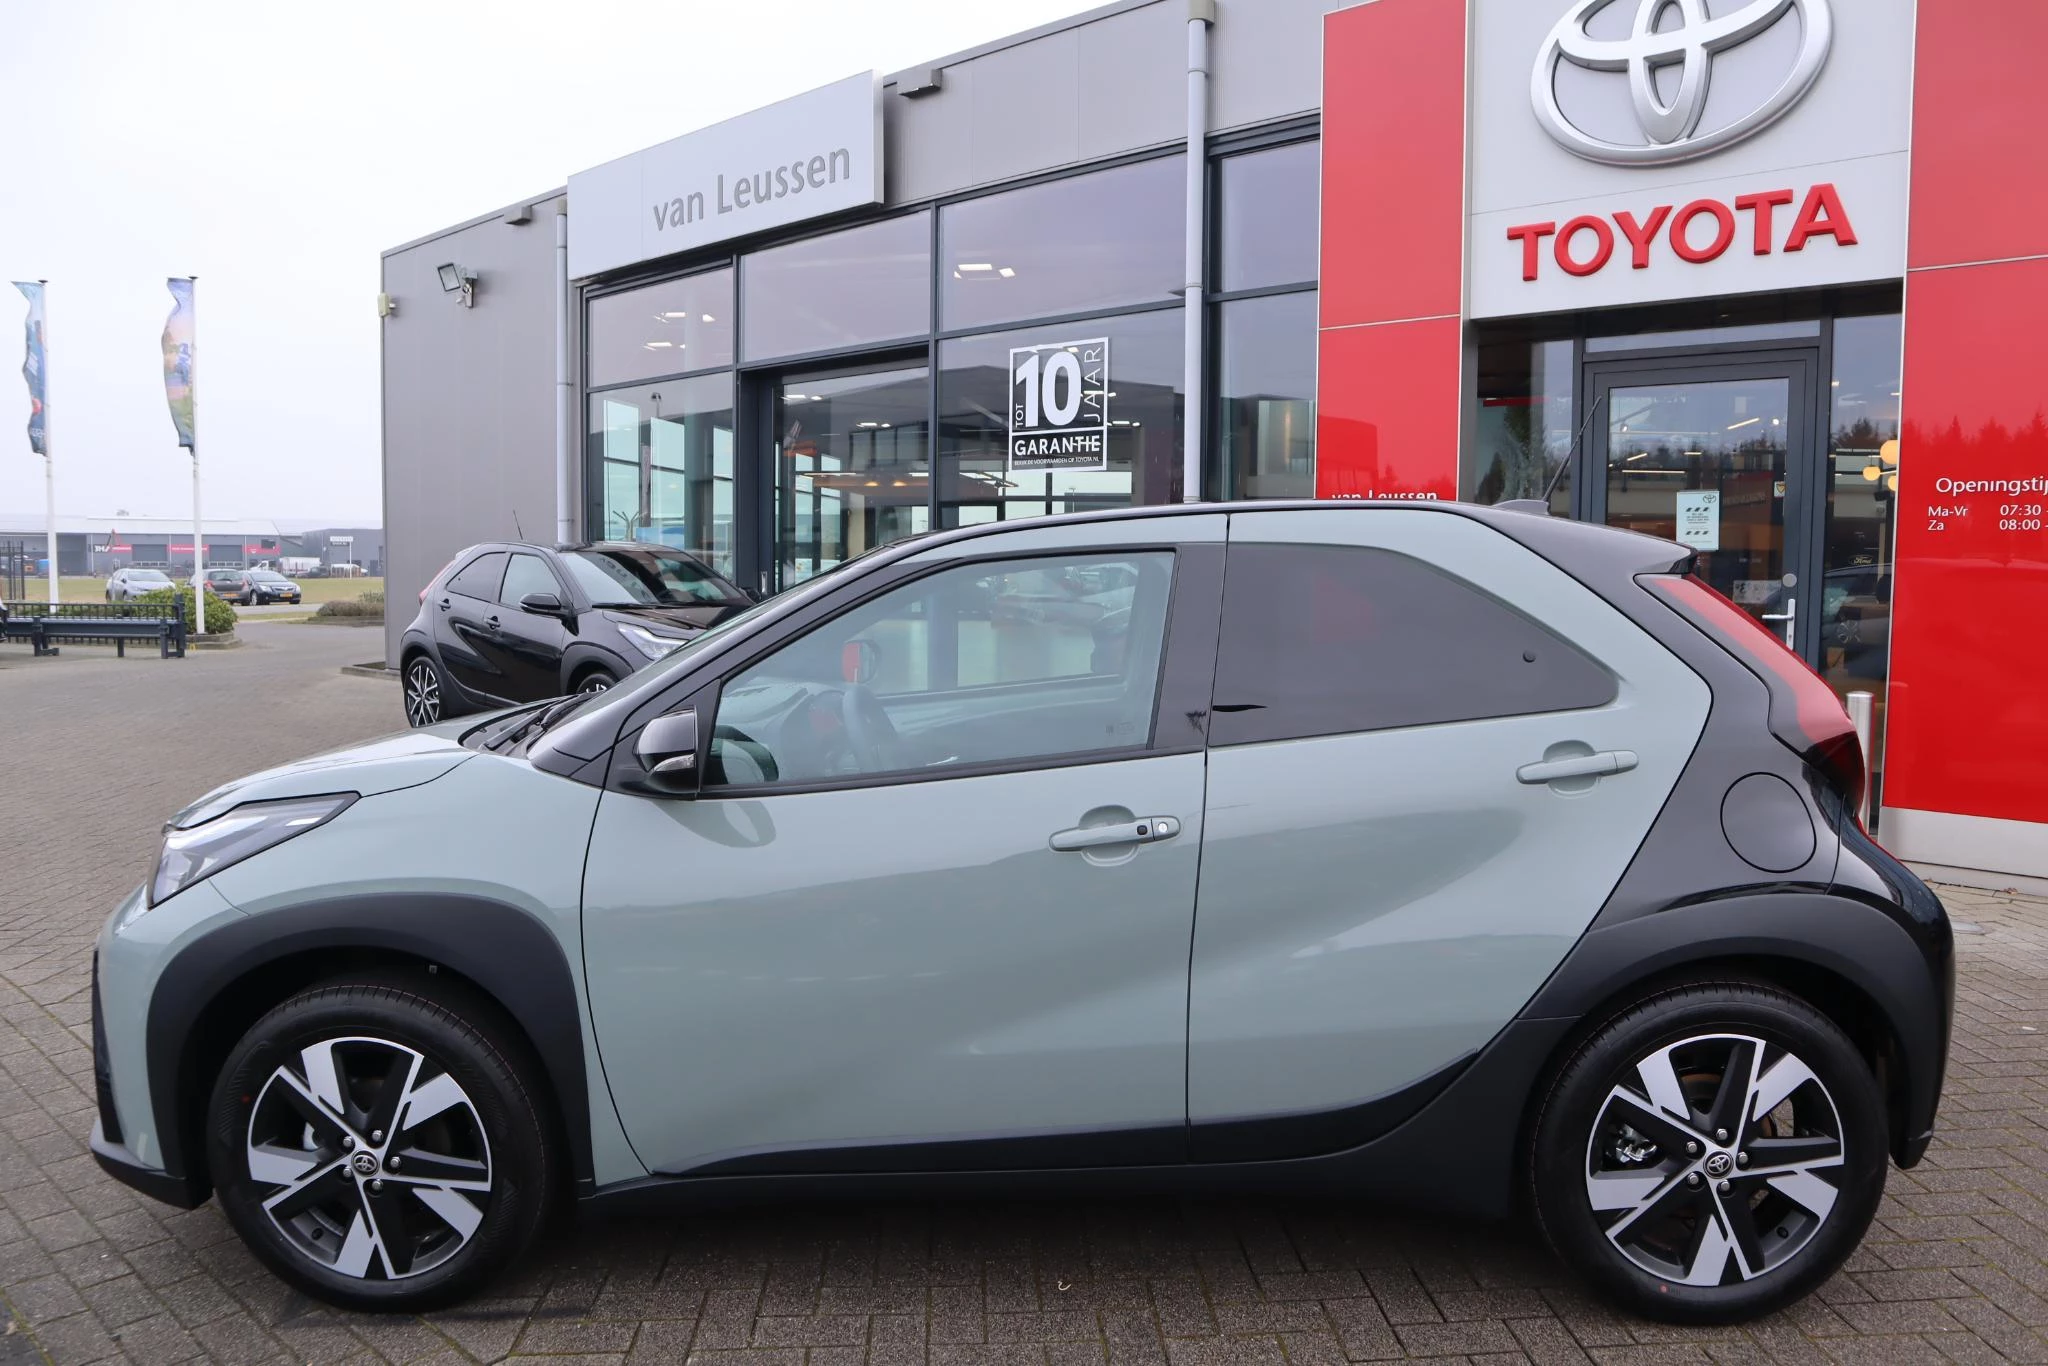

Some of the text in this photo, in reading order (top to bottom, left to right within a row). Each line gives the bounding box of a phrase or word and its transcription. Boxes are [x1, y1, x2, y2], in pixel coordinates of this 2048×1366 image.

[653, 148, 850, 231] van Leussen
[1507, 183, 1858, 282] TOYOTA
[1016, 351, 1082, 428] 10
[1084, 346, 1101, 422] JAAR
[1015, 403, 1024, 428] TOT
[1014, 435, 1101, 456] GARANTIE
[1927, 519, 2041, 531] Za 08:00
[1928, 504, 2042, 517] Ma-Vr 07:30
